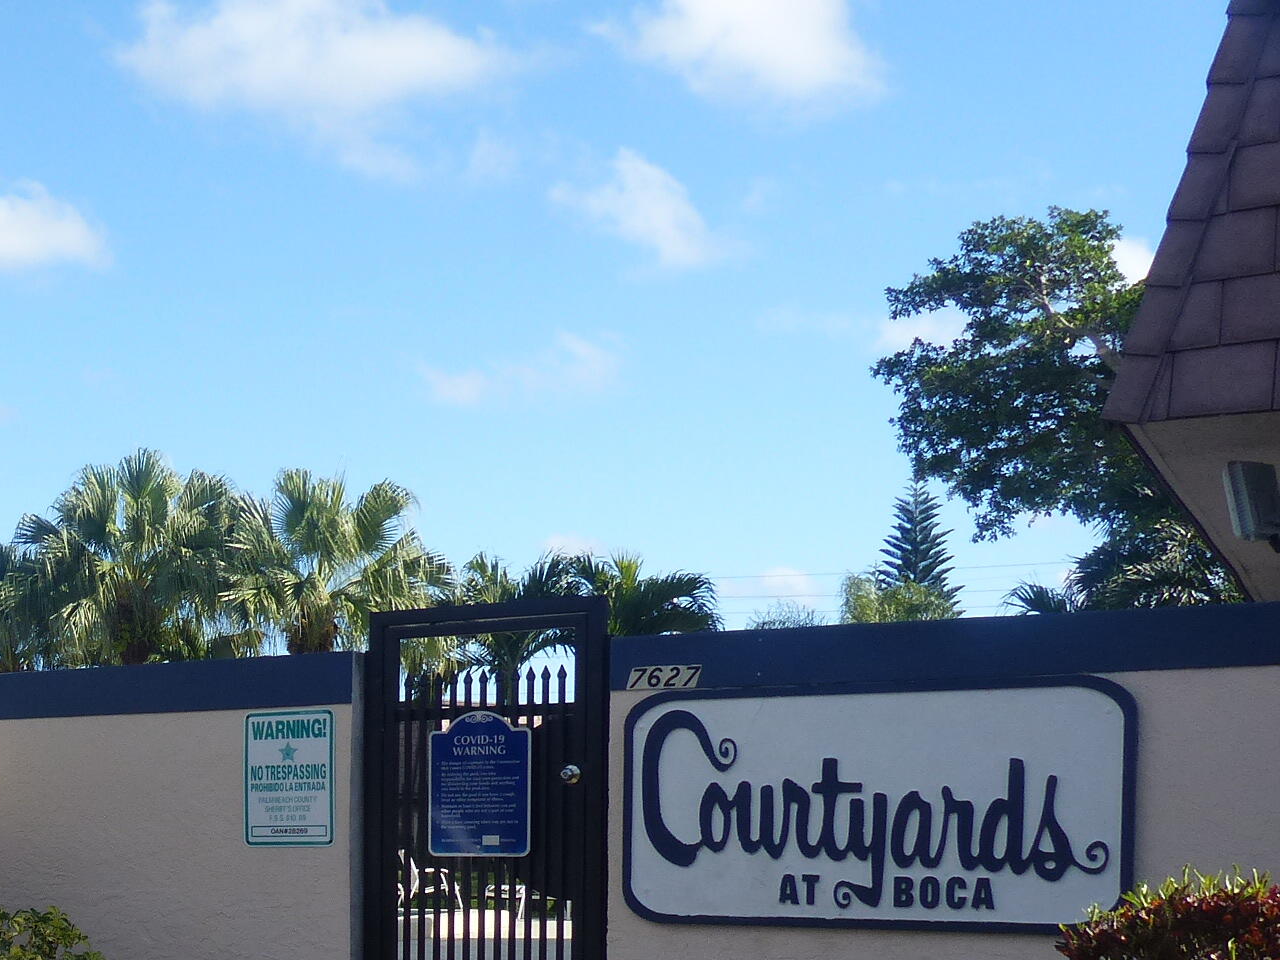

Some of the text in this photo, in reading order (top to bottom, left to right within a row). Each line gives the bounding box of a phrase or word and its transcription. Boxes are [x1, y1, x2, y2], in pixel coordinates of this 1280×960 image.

[629, 666, 701, 688] 7627
[252, 718, 327, 740] WARNING!
[454, 735, 505, 745] COVID-19
[453, 745, 506, 756] WARNING
[251, 763, 327, 781] NO TRESPASSING
[251, 781, 326, 792] PROHIBIDO LA ENTRADA
[642, 709, 1109, 908] Courtyards
[779, 873, 995, 910] AT BOCA
